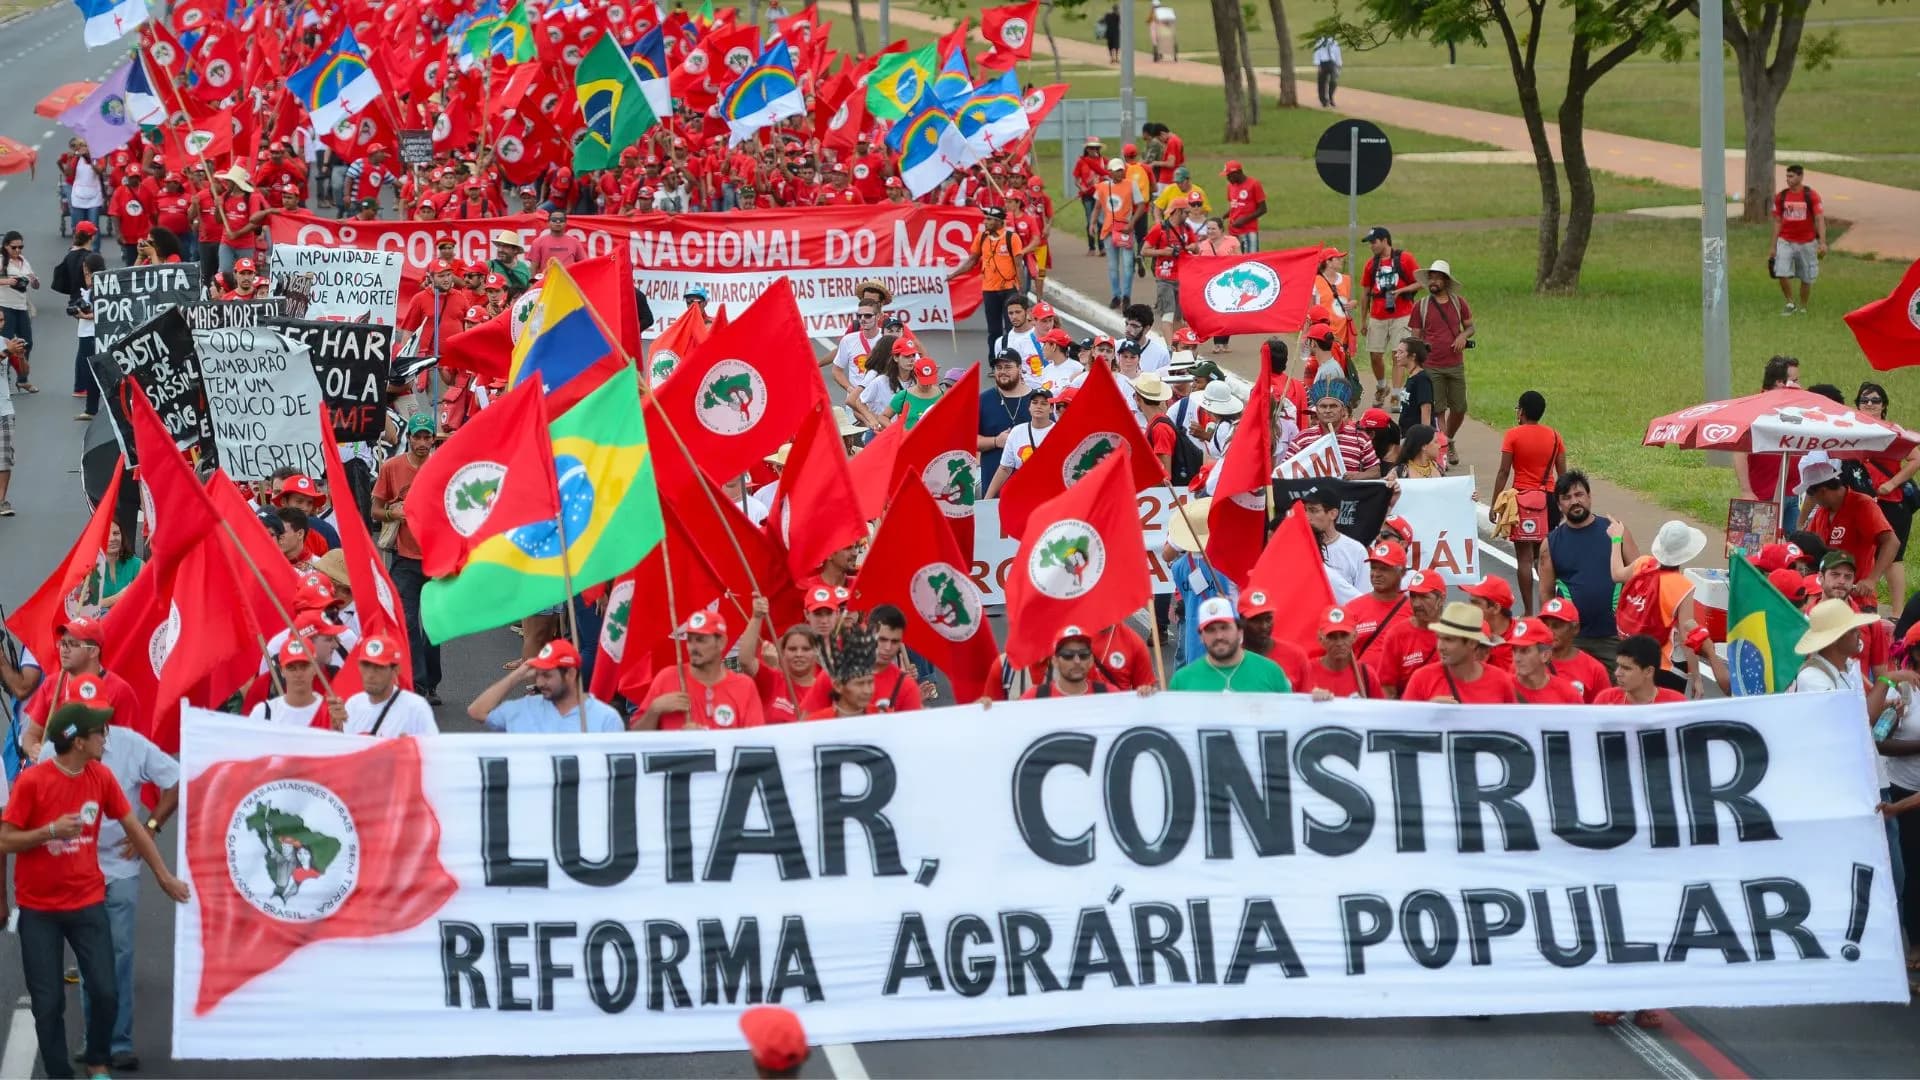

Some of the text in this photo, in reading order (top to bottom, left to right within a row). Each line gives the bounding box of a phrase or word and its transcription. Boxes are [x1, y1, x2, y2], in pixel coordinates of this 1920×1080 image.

[630, 229, 809, 267] NACIONAL
[826, 228, 875, 265] DO
[893, 220, 979, 267] MS
[271, 249, 284, 267] A
[296, 250, 381, 266] IMPUNIDADE
[93, 273, 121, 297] NA
[131, 268, 190, 293] LUTA
[646, 280, 679, 301] APOIA
[695, 276, 776, 302] EMARCAÇ
[873, 272, 944, 295] NDÍGENAS
[94, 297, 134, 324] POR
[336, 290, 345, 304] A
[918, 305, 949, 324] JÁ!
[112, 330, 170, 375] BASTA
[192, 328, 255, 354] TODO
[151, 356, 175, 383] DE
[202, 346, 287, 375] CAMBURÃO
[204, 377, 275, 395] TEM UM
[316, 365, 379, 402] OLA
[210, 394, 311, 417] POUCO DE
[216, 421, 267, 441] NAVIO
[1779, 434, 1861, 449] KIBON
[243, 781, 328, 810] TRABALHADORES
[478, 720, 1783, 889] LUTAR, CONSTRUIR
[262, 902, 308, 920] BRASIL
[438, 915, 826, 1015] REFORMA
[882, 885, 1308, 998] AGRÁRIA
